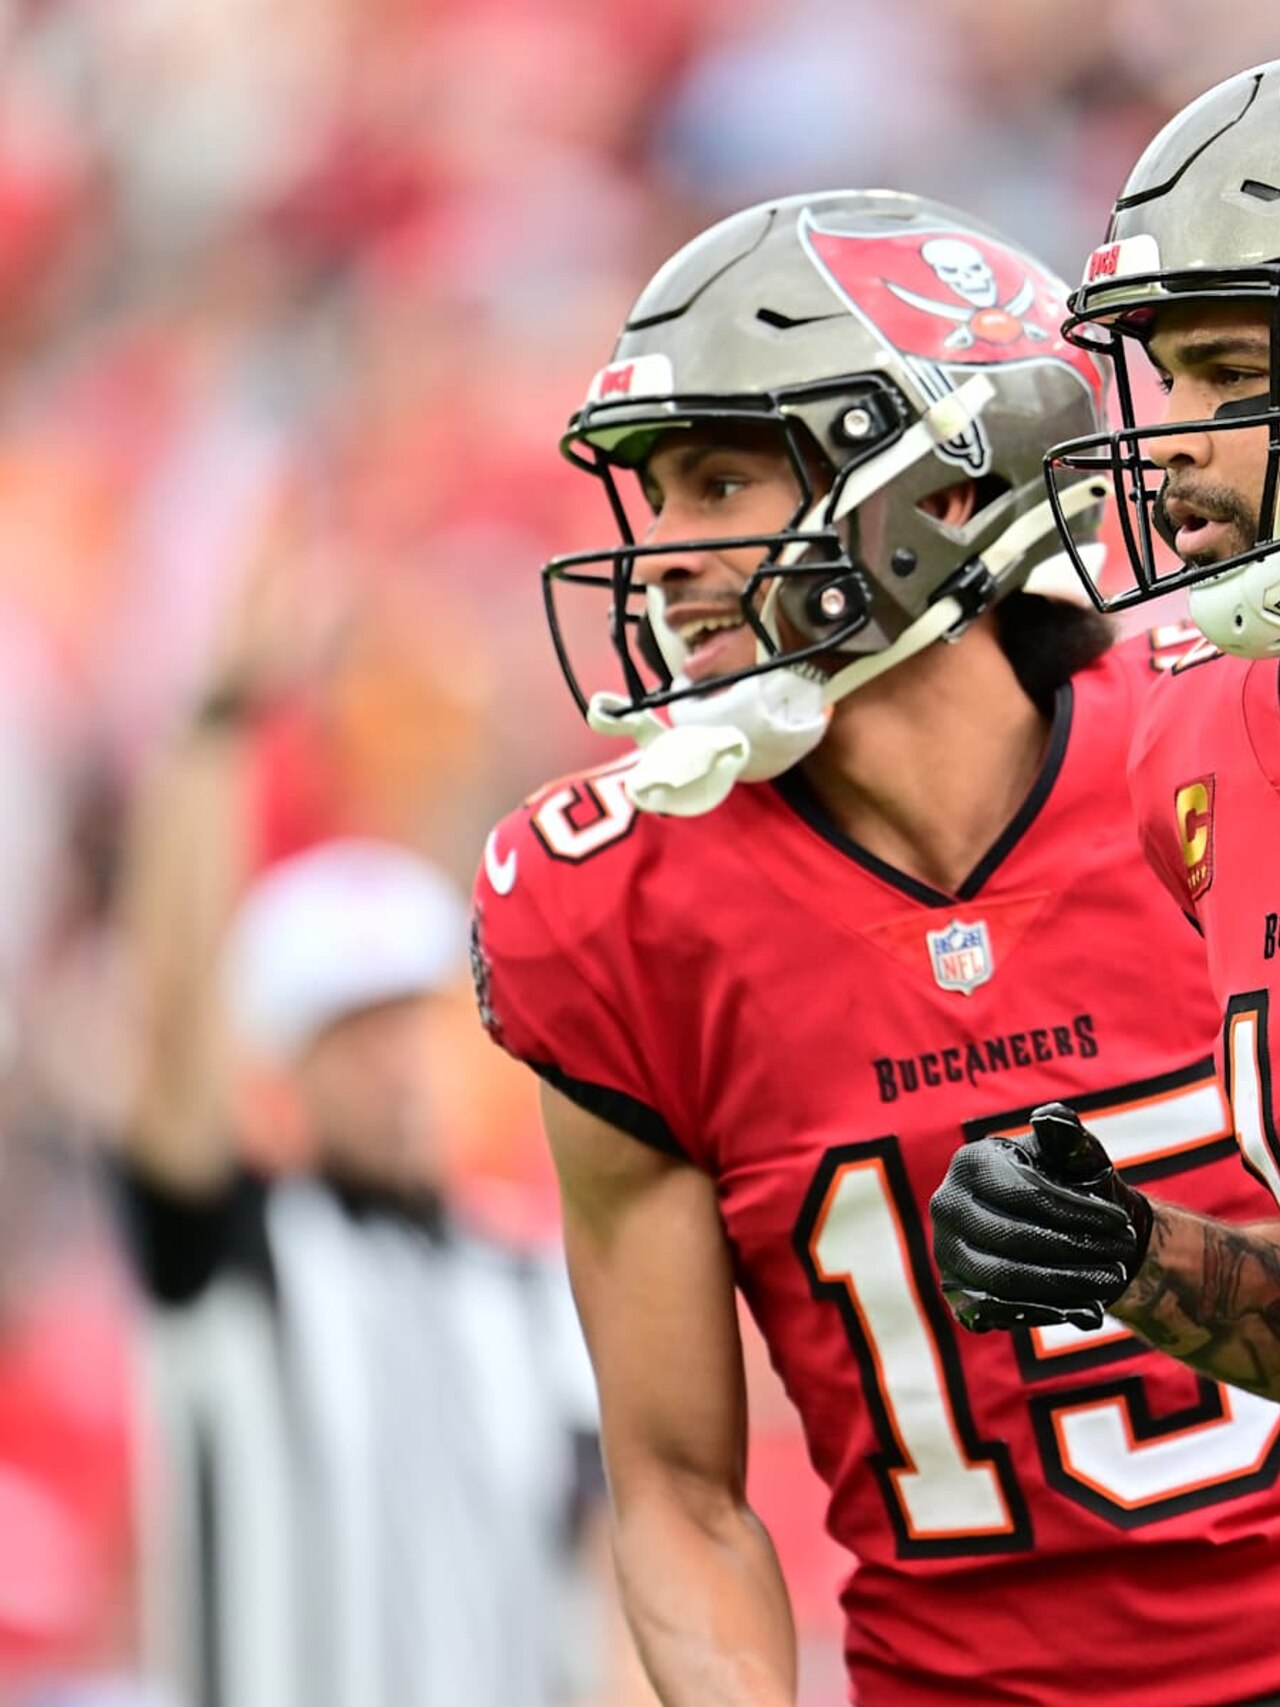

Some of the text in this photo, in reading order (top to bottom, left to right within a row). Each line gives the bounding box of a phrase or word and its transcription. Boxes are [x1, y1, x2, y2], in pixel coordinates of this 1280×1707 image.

[1176, 783, 1209, 868] C
[942, 950, 985, 980] NFL
[873, 1014, 1099, 1104] BUCCANEERS
